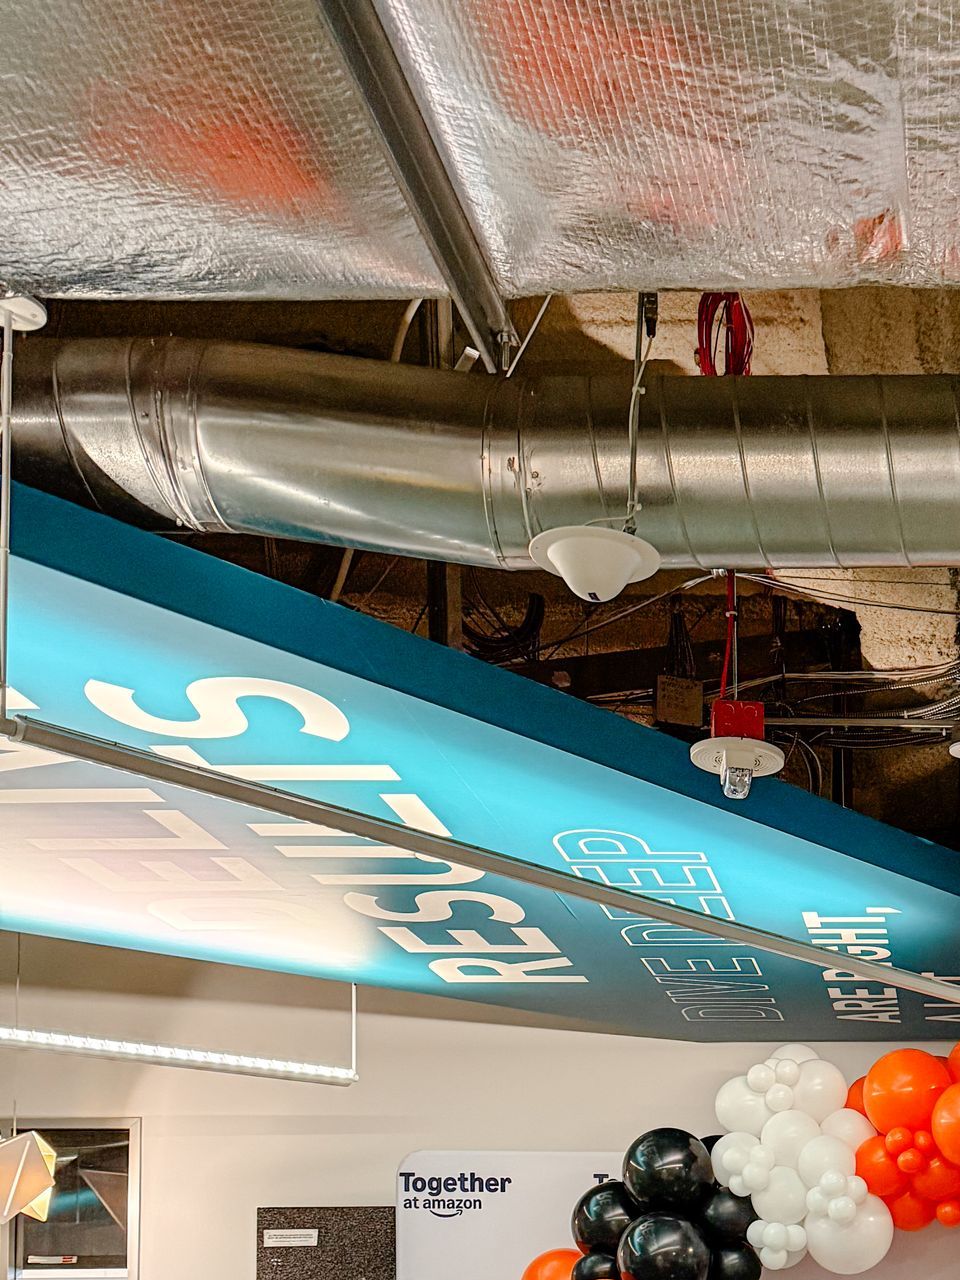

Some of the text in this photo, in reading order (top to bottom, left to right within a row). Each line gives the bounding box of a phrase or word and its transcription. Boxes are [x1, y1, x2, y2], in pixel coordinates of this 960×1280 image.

[84, 677, 589, 982] RESULTS
[640, 957, 784, 1021] DIVE
[802, 907, 903, 1023] ARE RGHT,
[399, 1173, 511, 1196] Together
[404, 1197, 481, 1210] at amazon
